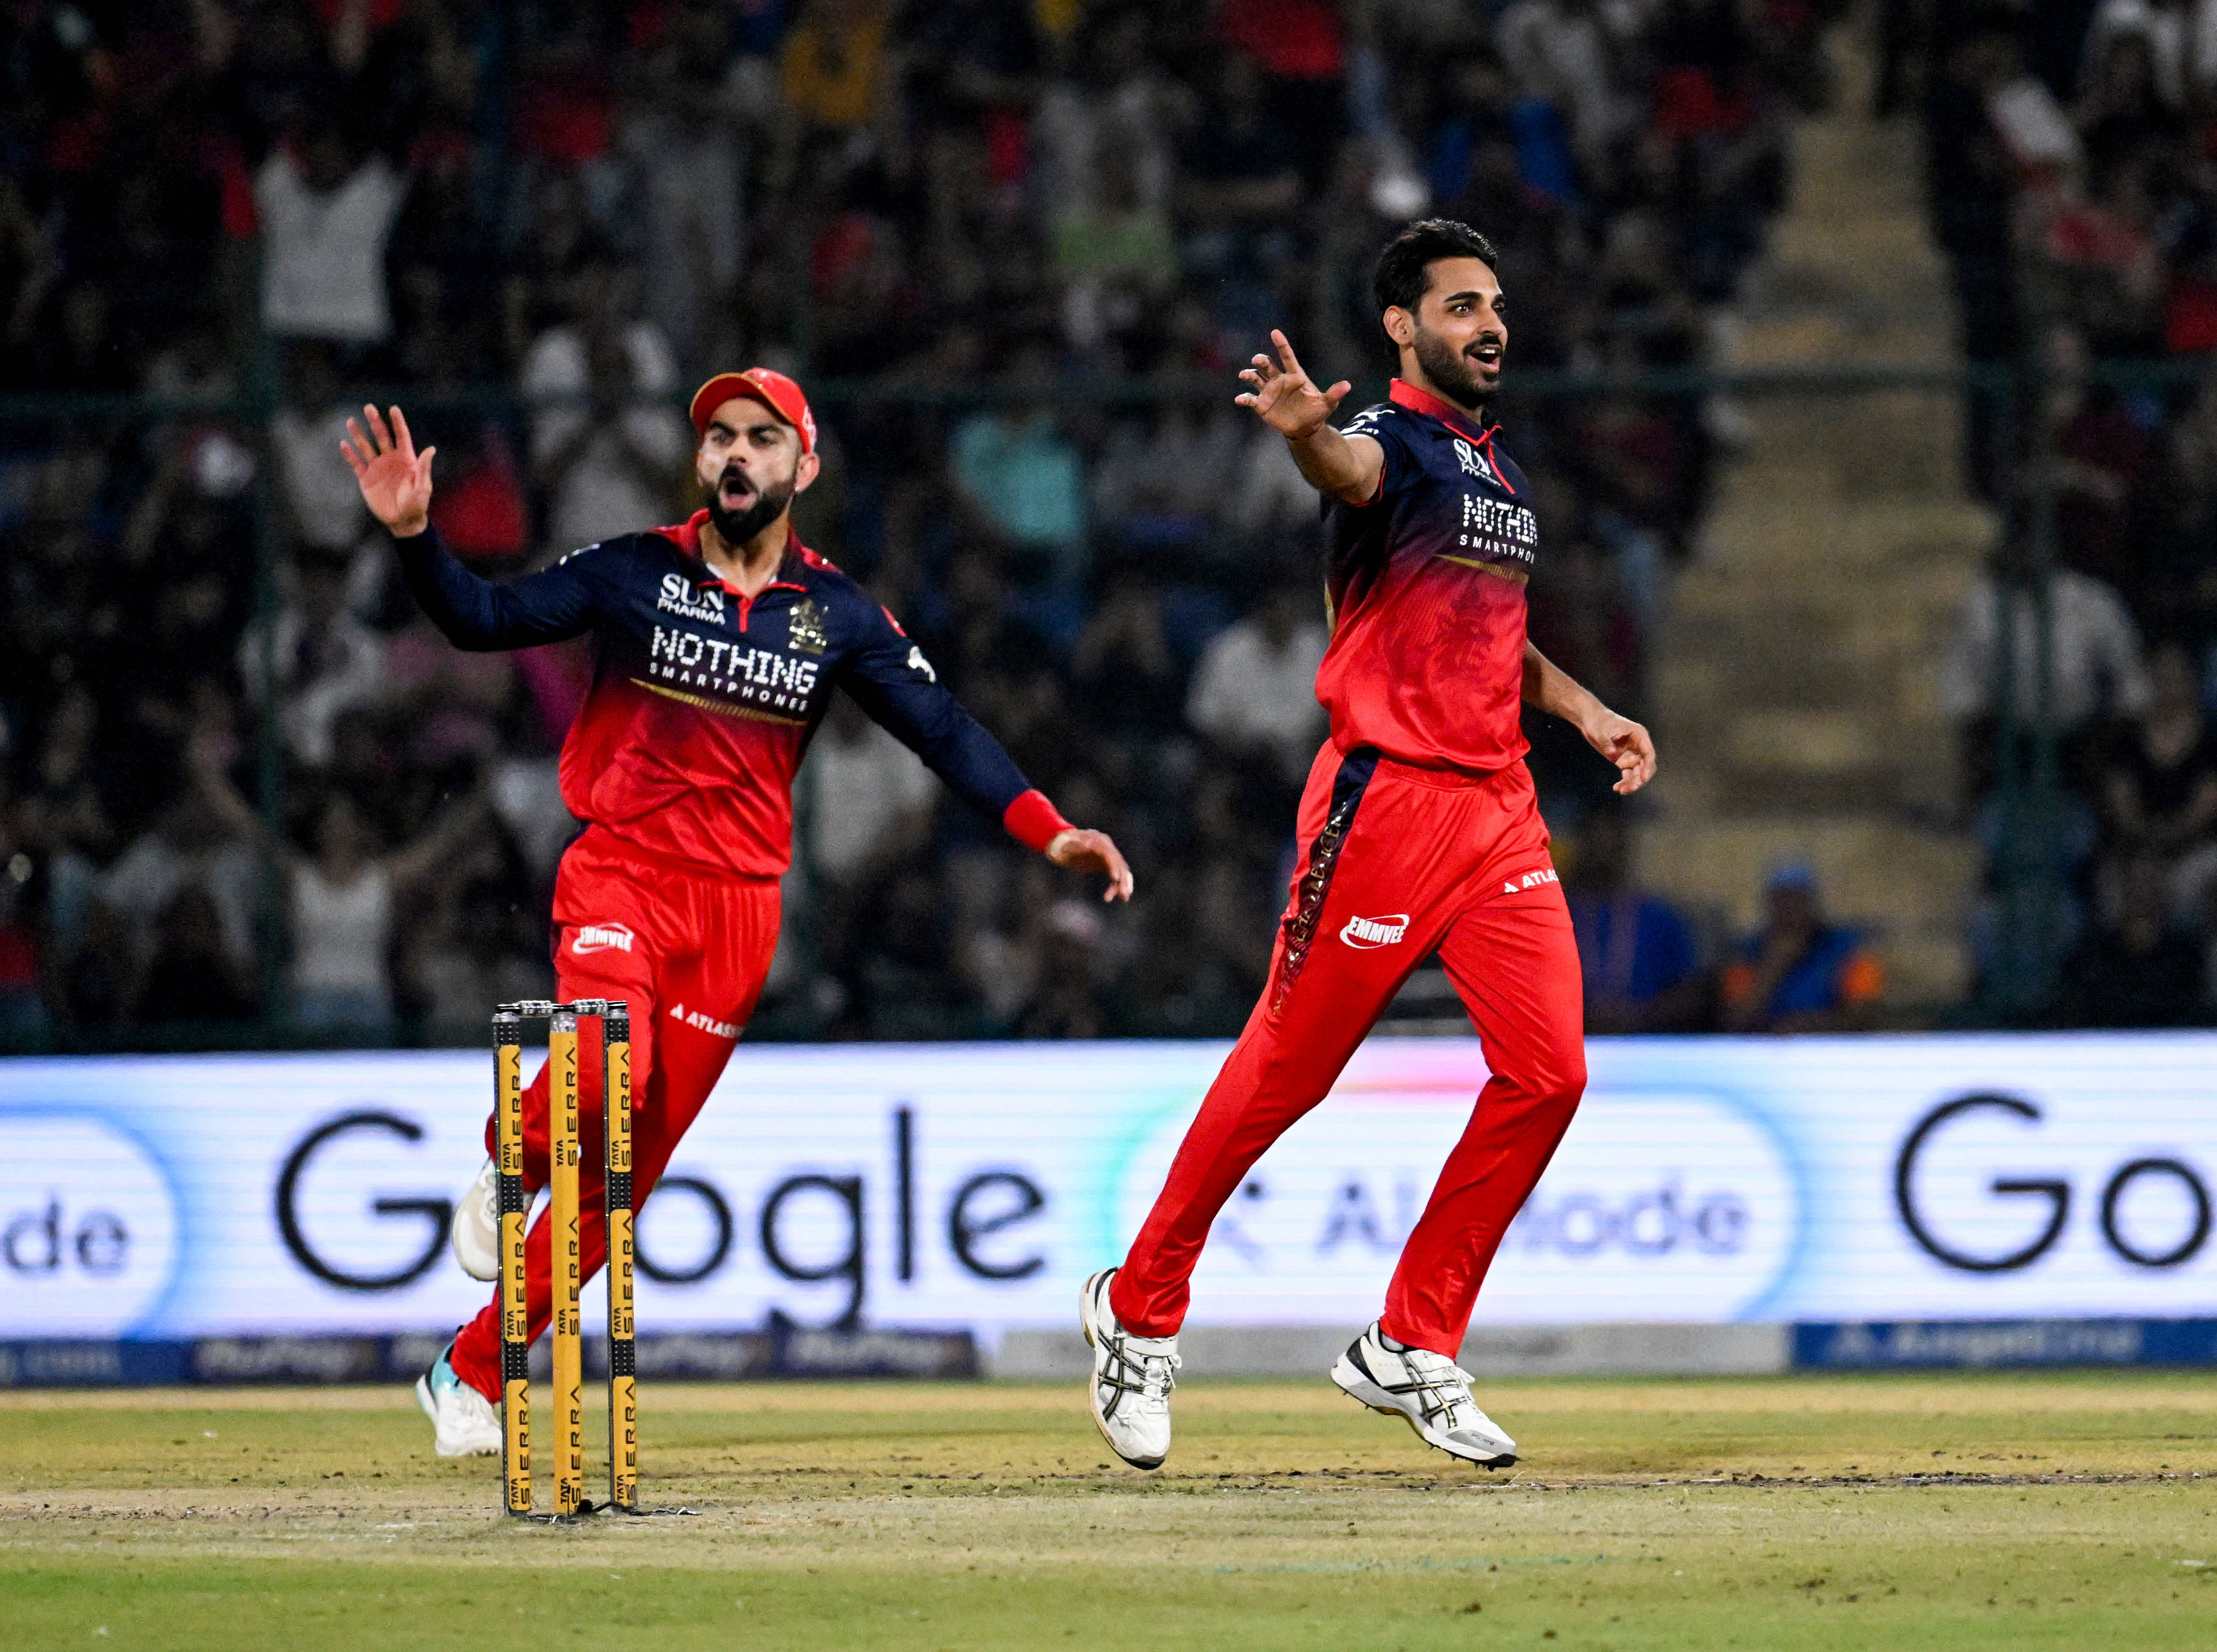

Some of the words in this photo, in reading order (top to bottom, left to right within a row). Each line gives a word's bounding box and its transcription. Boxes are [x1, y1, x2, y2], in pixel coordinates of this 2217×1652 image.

[657, 597, 726, 626] PHARMA
[660, 574, 725, 611] SUN
[649, 662, 809, 712] SMARTPHONES
[651, 625, 818, 695] NOTHING
[1347, 915, 1407, 944] EMMVEE
[512, 1051, 522, 1169] SIERRA
[565, 1046, 578, 1166] SIERRA
[620, 1048, 631, 1166] SIERRA
[275, 1107, 1045, 1329] Gogle
[514, 1218, 526, 1336] SIERRA
[568, 1216, 580, 1335] SIERRA
[622, 1214, 633, 1334] SIERRA
[510, 1478, 519, 1505] TATA
[519, 1386, 530, 1504] SIERRA
[616, 1474, 625, 1501] TATA
